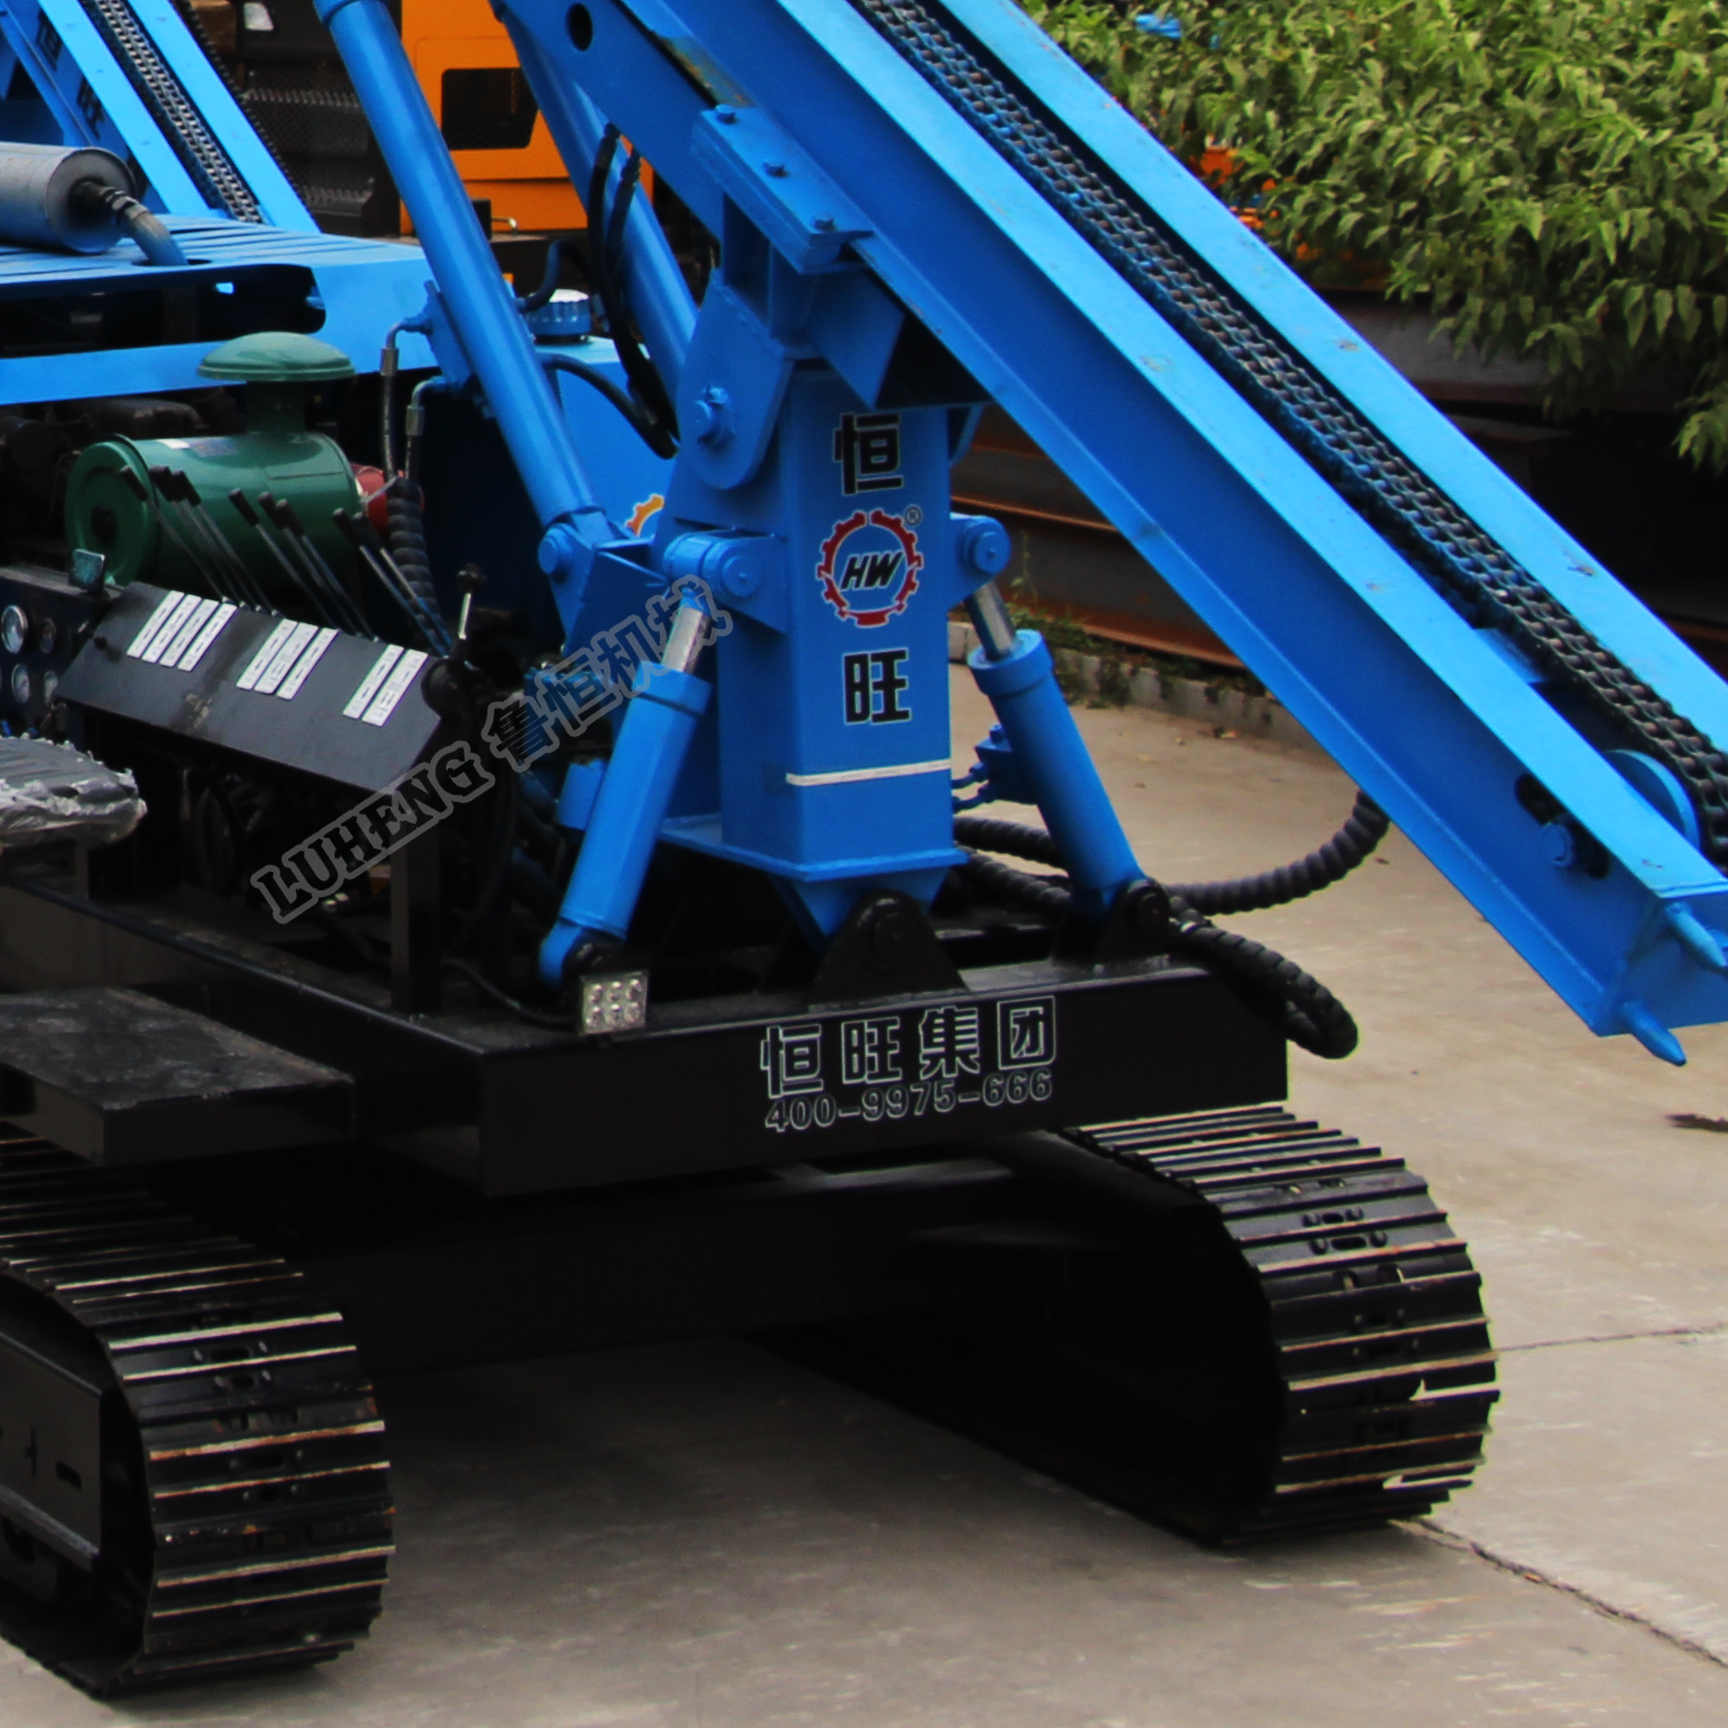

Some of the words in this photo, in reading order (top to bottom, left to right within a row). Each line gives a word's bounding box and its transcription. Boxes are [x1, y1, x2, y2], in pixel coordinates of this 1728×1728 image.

[841, 551, 905, 591] HW
[760, 995, 1056, 1100] 恒旺集团
[765, 1069, 1053, 1133] 400-9975-666
